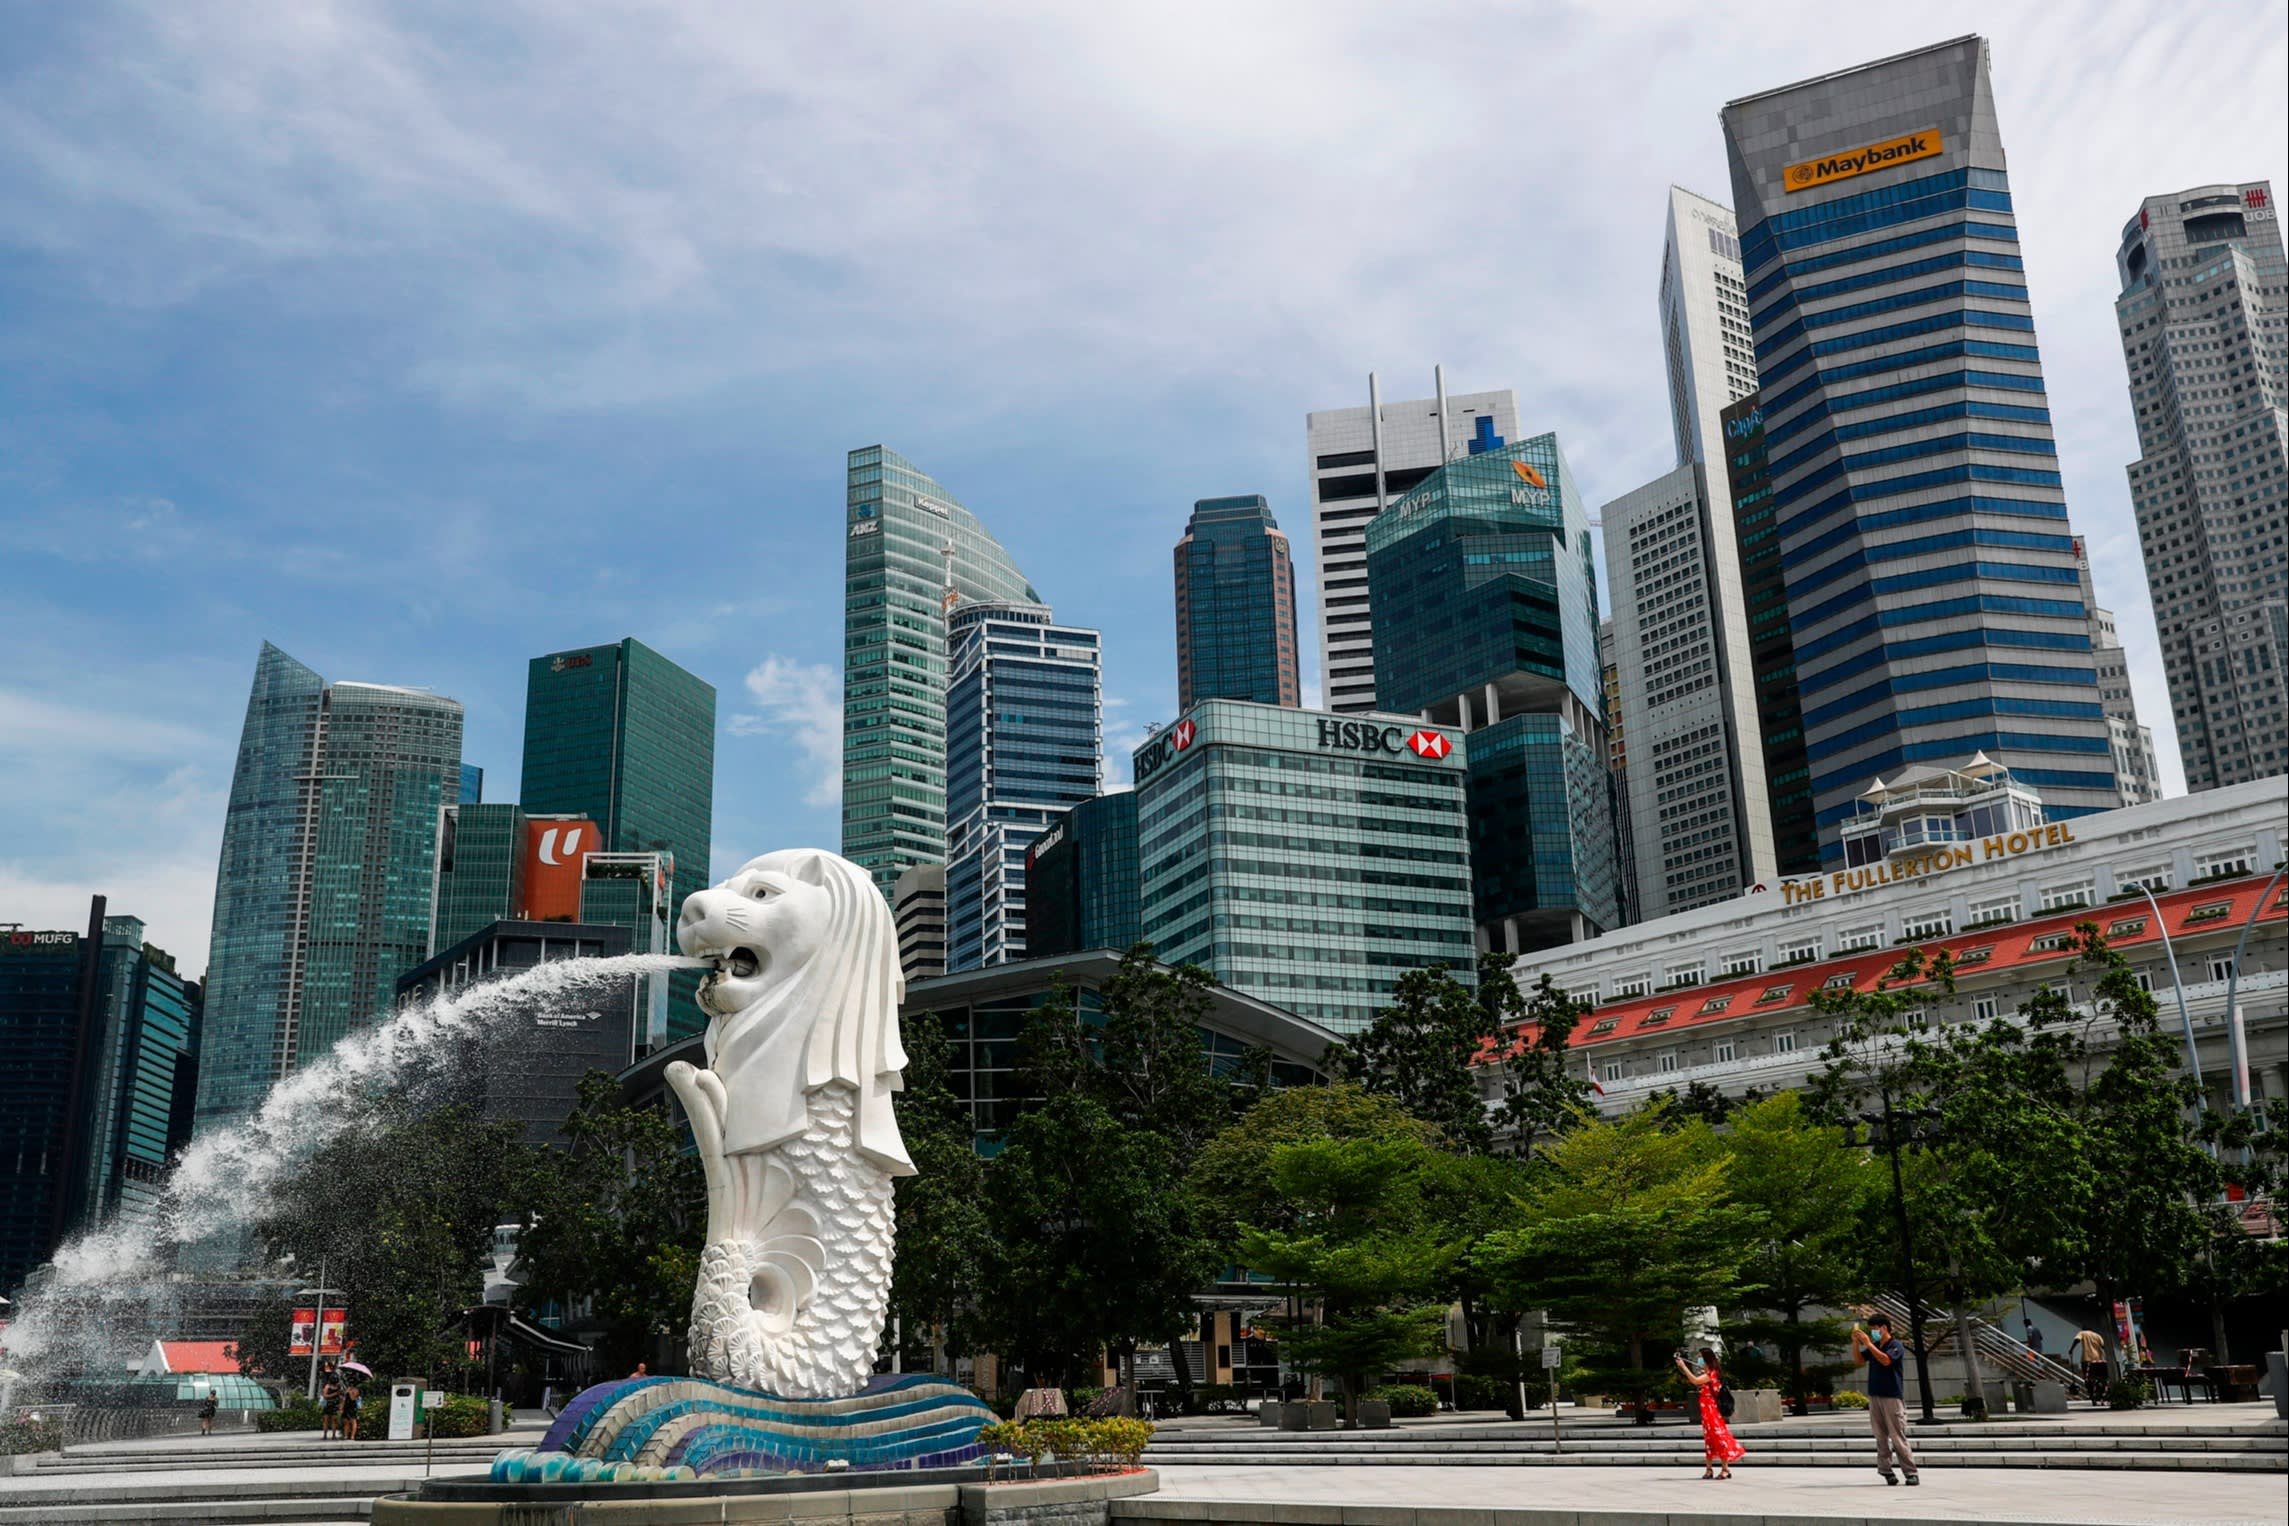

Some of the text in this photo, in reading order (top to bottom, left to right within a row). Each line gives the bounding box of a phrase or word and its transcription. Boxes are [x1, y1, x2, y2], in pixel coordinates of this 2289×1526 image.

[1816, 137, 1927, 179] Maybank
[2244, 208, 2277, 223] UOB
[1401, 491, 1432, 519] MYP
[1511, 489, 1551, 507] MYP
[850, 520, 879, 537] ANZ
[1316, 718, 1404, 755] HSBC
[1133, 732, 1175, 785] HSBC
[1780, 822, 2076, 906] THE FULLERTON HOTEL
[33, 933, 73, 944] MUFG
